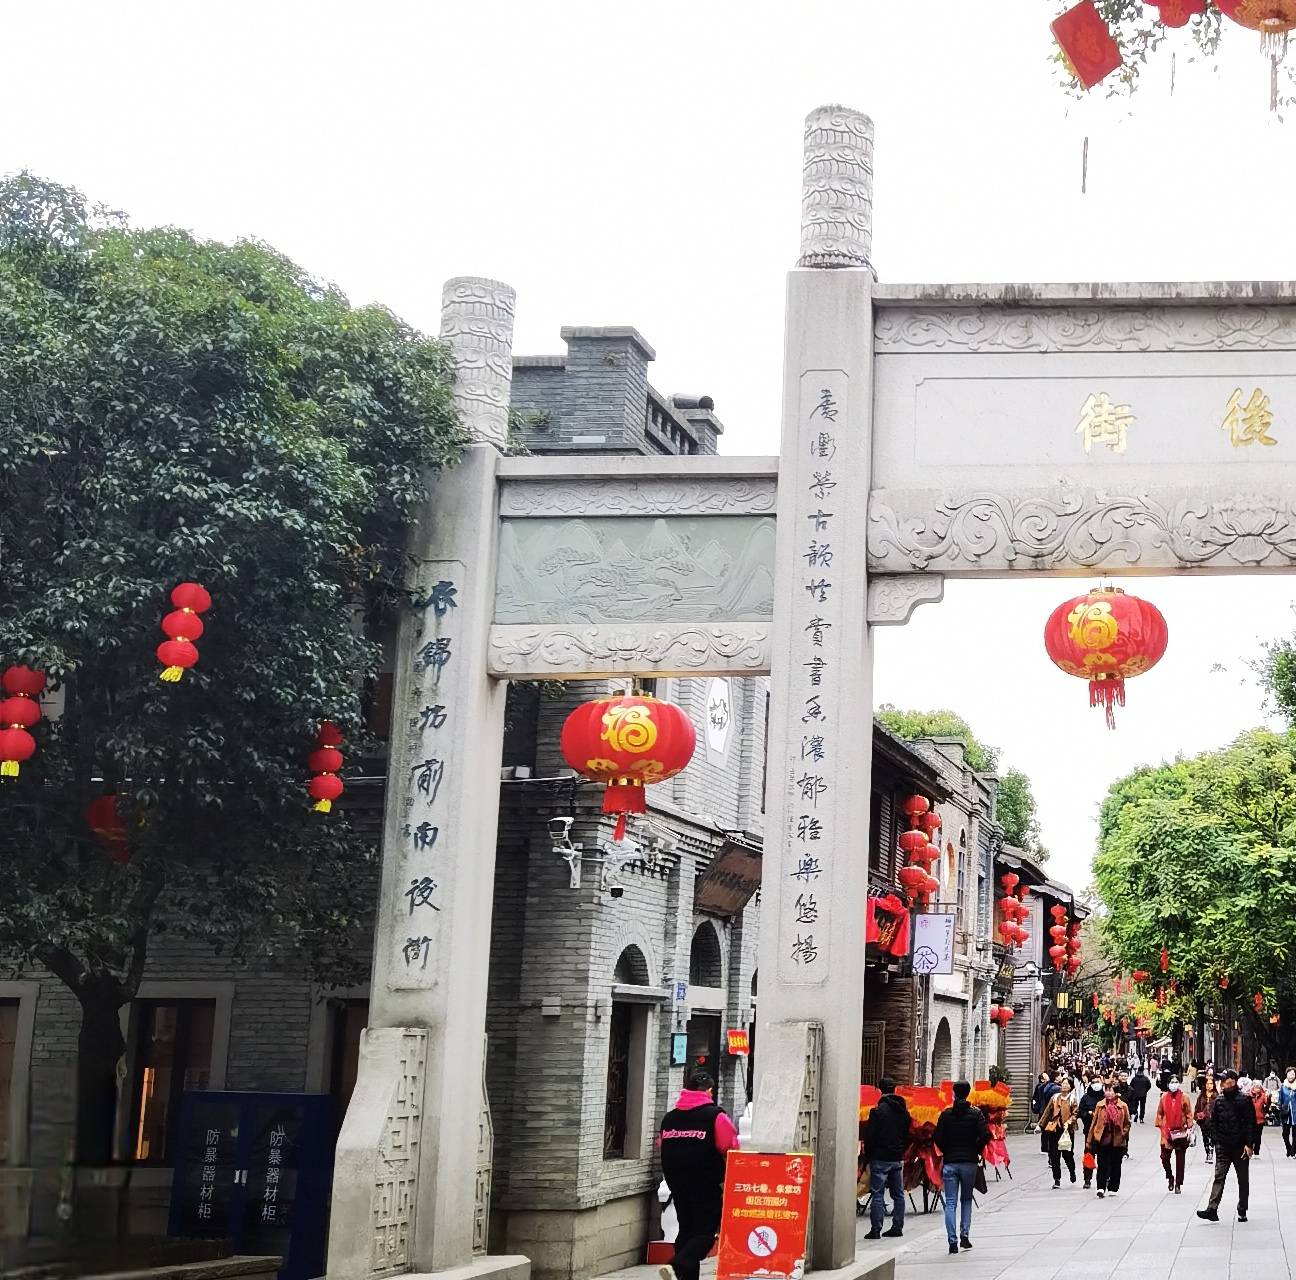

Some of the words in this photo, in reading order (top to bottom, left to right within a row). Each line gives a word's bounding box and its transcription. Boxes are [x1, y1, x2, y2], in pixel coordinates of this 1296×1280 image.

[198, 1129, 221, 1219] 防暴器材柜
[261, 1130, 285, 1223] 防暴器材柜
